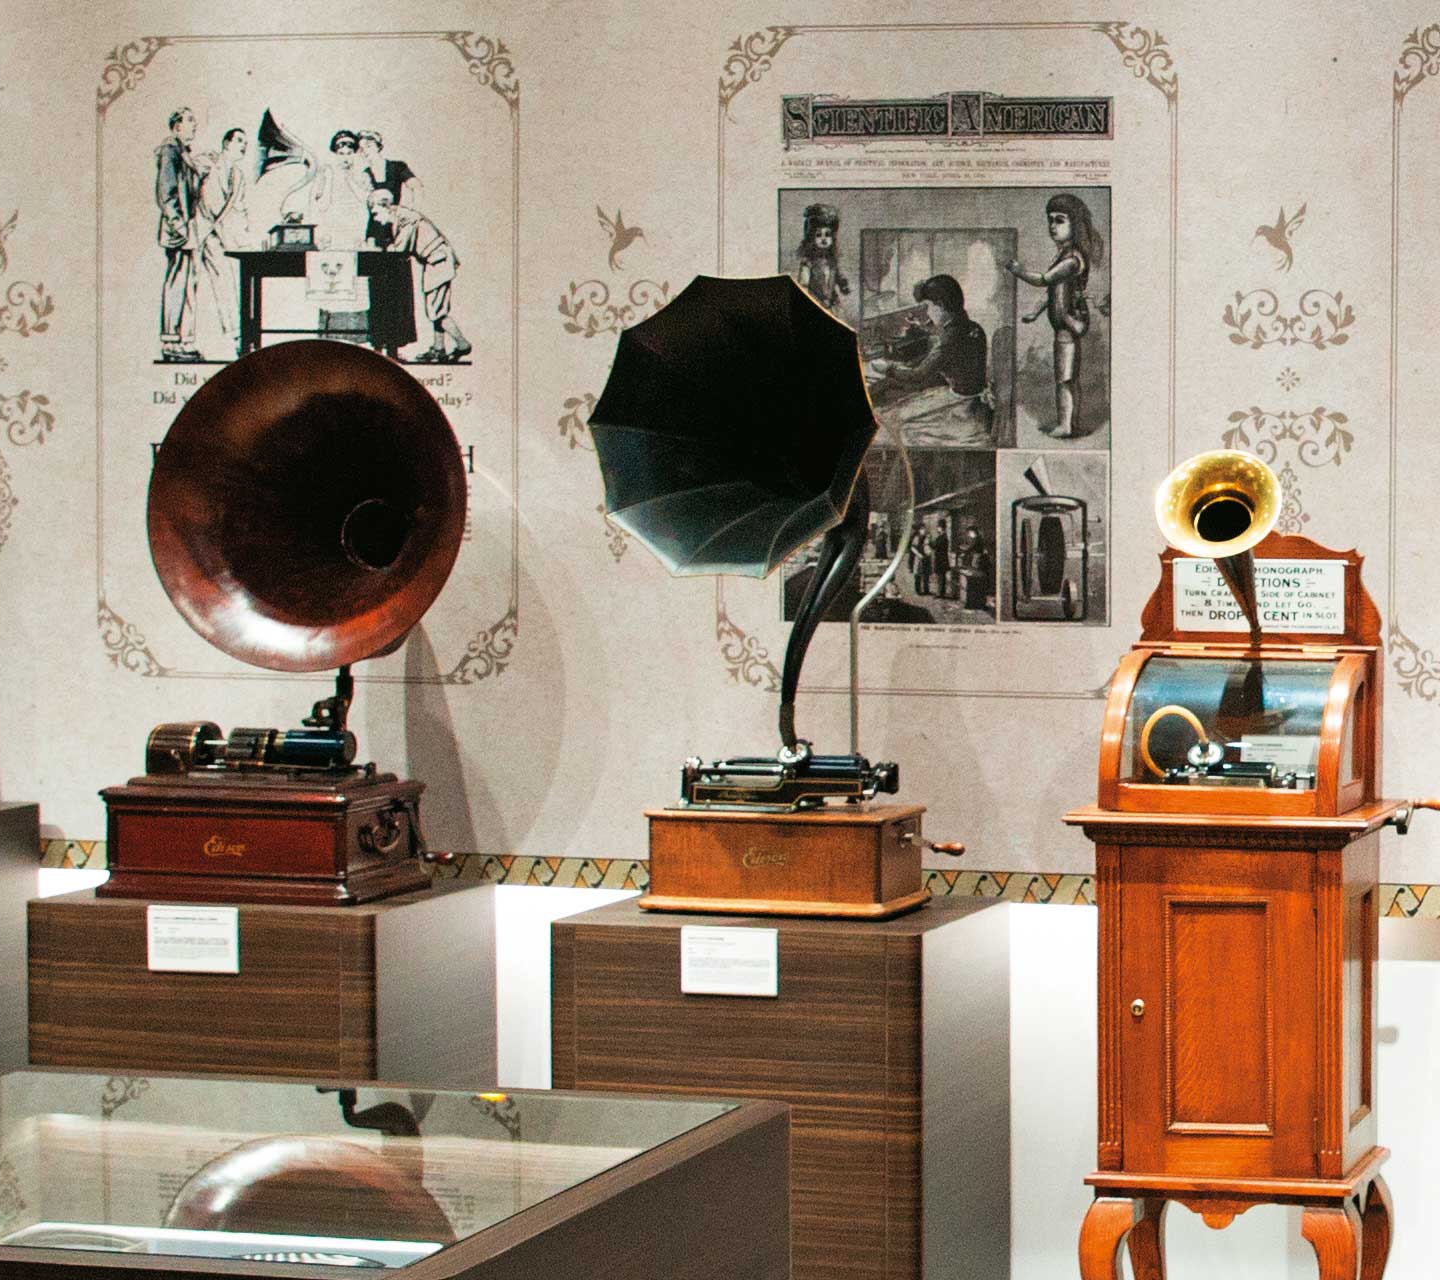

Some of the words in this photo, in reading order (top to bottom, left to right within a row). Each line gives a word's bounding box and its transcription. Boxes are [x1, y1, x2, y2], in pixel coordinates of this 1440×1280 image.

[783, 97, 946, 140] SCIENTIFIC
[953, 96, 1107, 135] AMERICAN
[175, 372, 197, 385] Did
[153, 391, 176, 404] Did
[1263, 611, 1298, 621] CENT
